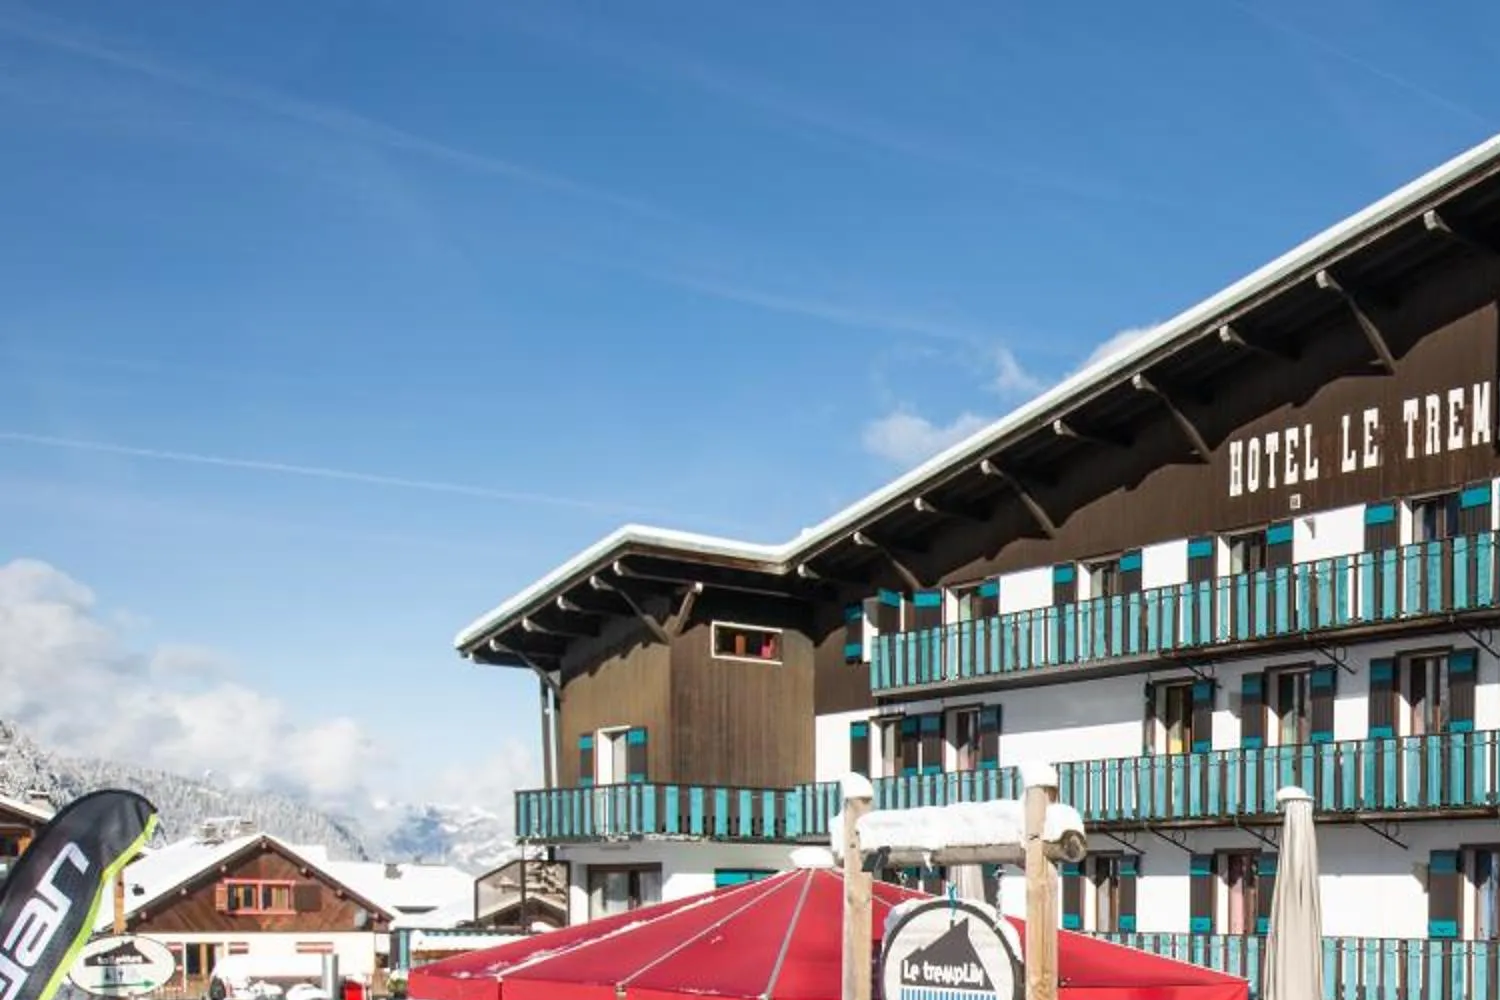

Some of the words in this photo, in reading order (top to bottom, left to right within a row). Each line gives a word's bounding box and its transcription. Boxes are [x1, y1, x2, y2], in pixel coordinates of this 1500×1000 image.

[1229, 423, 1319, 497] HOTEL
[1341, 407, 1380, 473] LE
[903, 959, 920, 981] Le
